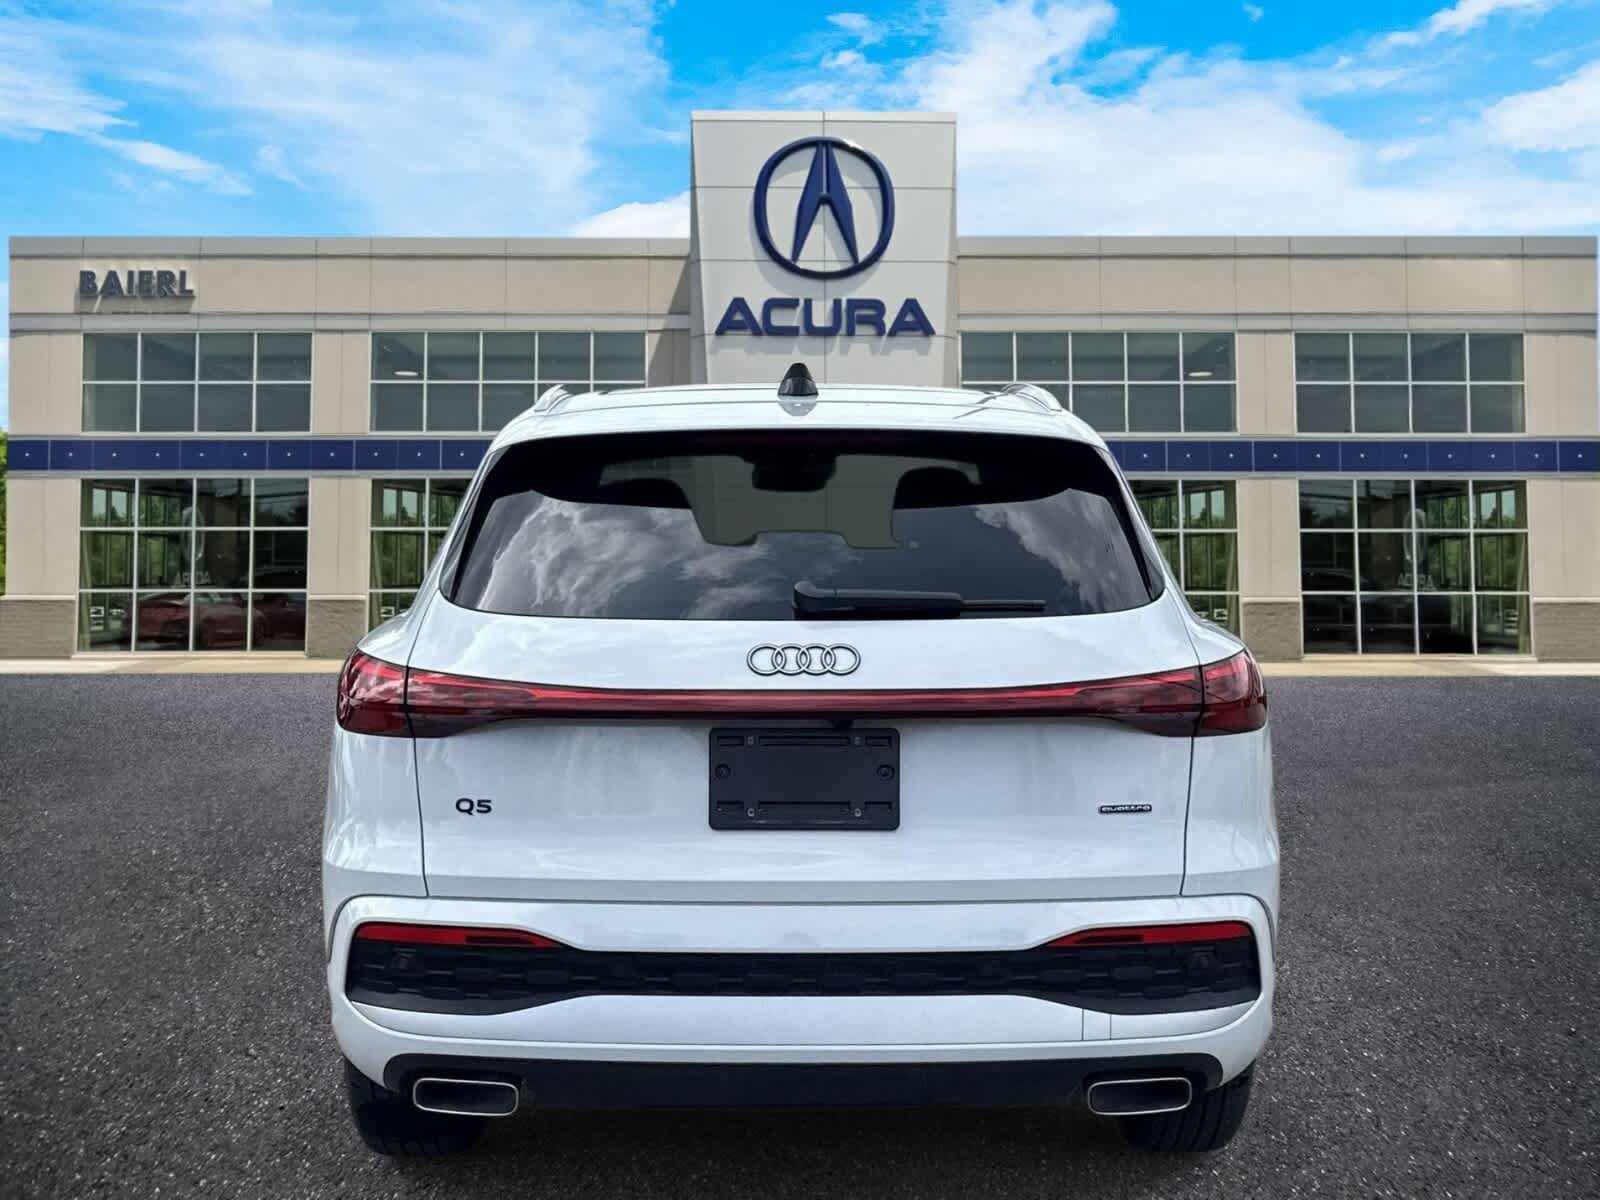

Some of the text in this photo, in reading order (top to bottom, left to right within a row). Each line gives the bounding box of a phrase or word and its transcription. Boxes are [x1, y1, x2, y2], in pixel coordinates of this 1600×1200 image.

[79, 270, 195, 296] BAIERL
[715, 297, 936, 336] ACURA
[456, 798, 492, 815] Q5
